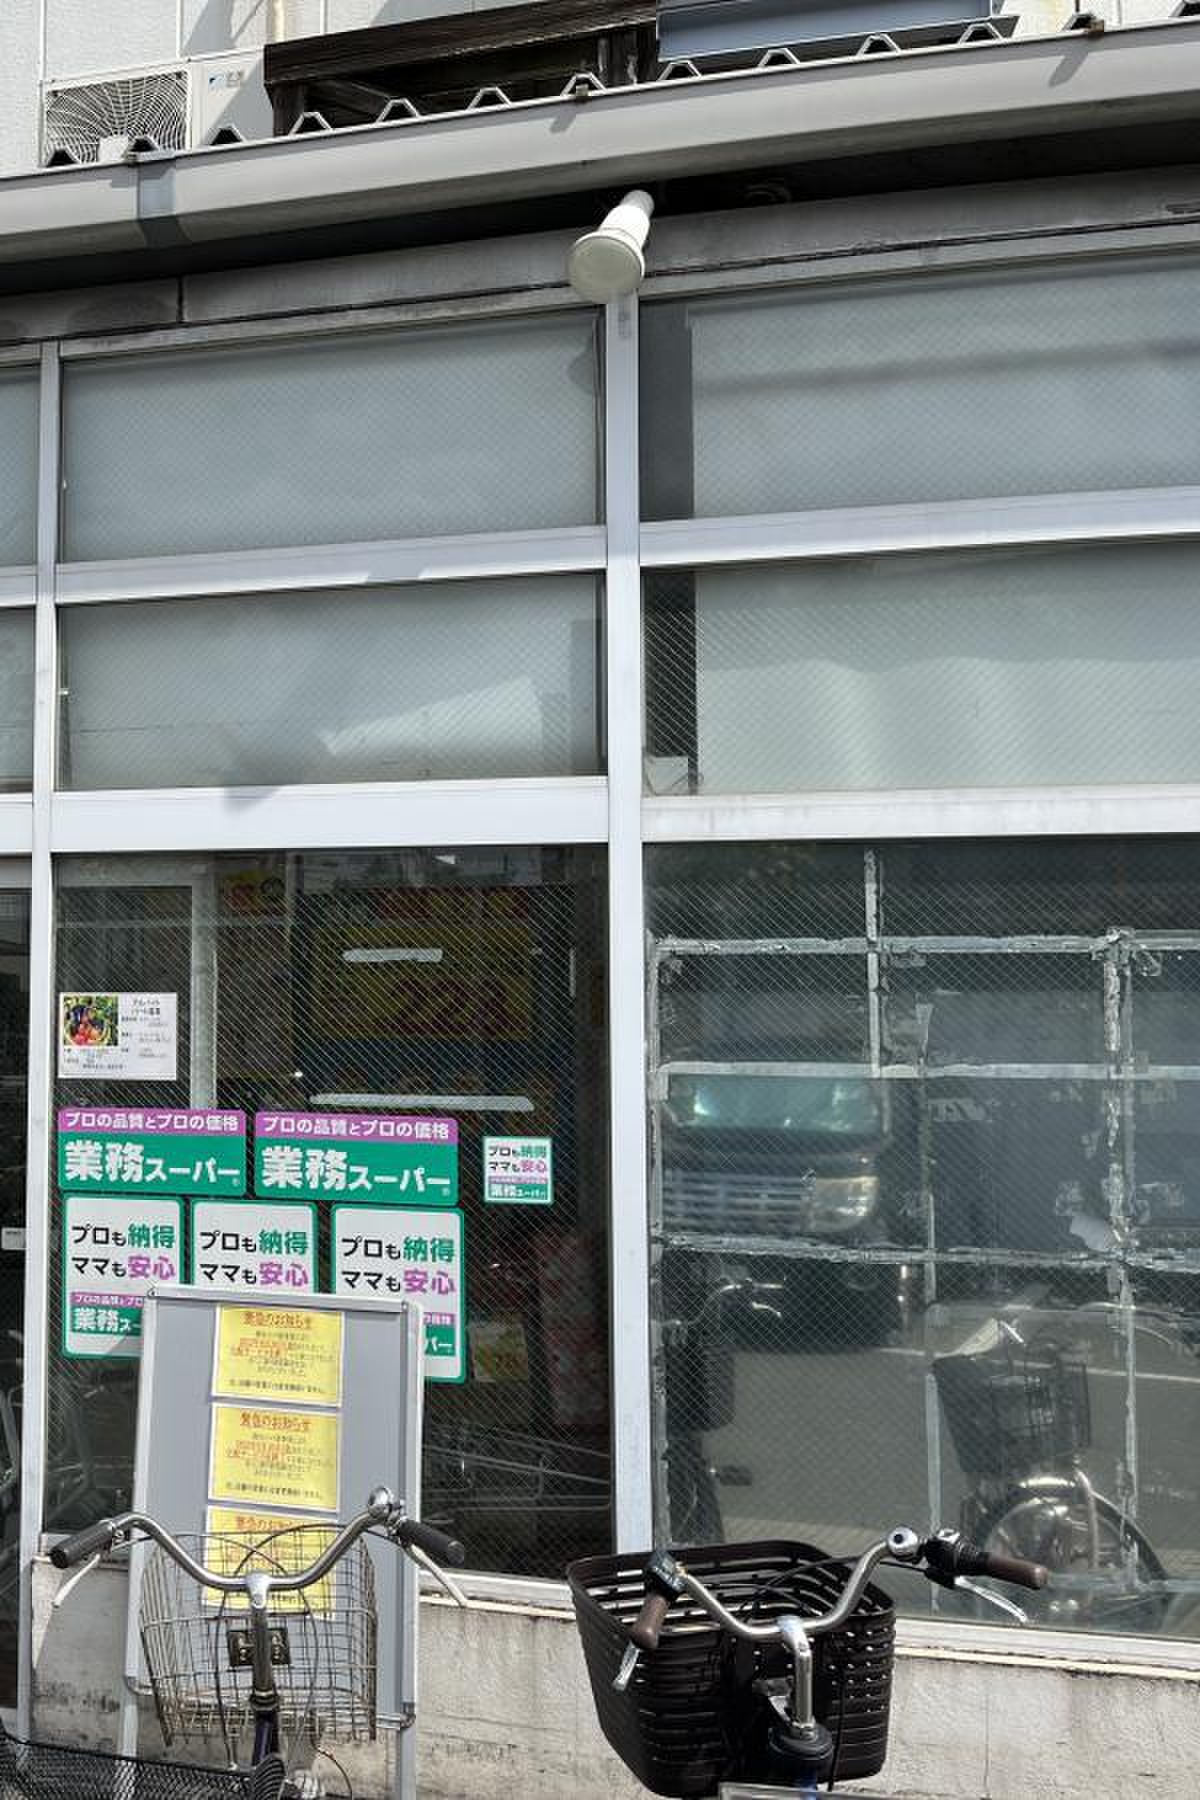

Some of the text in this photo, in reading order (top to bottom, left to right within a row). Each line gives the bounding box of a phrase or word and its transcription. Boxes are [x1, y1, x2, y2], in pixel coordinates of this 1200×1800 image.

[65, 1112, 240, 1132] プロの品質とプロの価格
[263, 1115, 450, 1140] プロの品質とプロの価格
[64, 1139, 241, 1184] 業務スーパー
[261, 1145, 451, 1193] 業務スーパー
[71, 1221, 176, 1249] プロも納得
[199, 1229, 308, 1255] プロも納得
[340, 1234, 456, 1264] プロも納得
[71, 1254, 176, 1281] ママも安心
[199, 1261, 309, 1286] ママも安心
[340, 1267, 456, 1295] ママも安心
[73, 1306, 141, 1333] 業務スー
